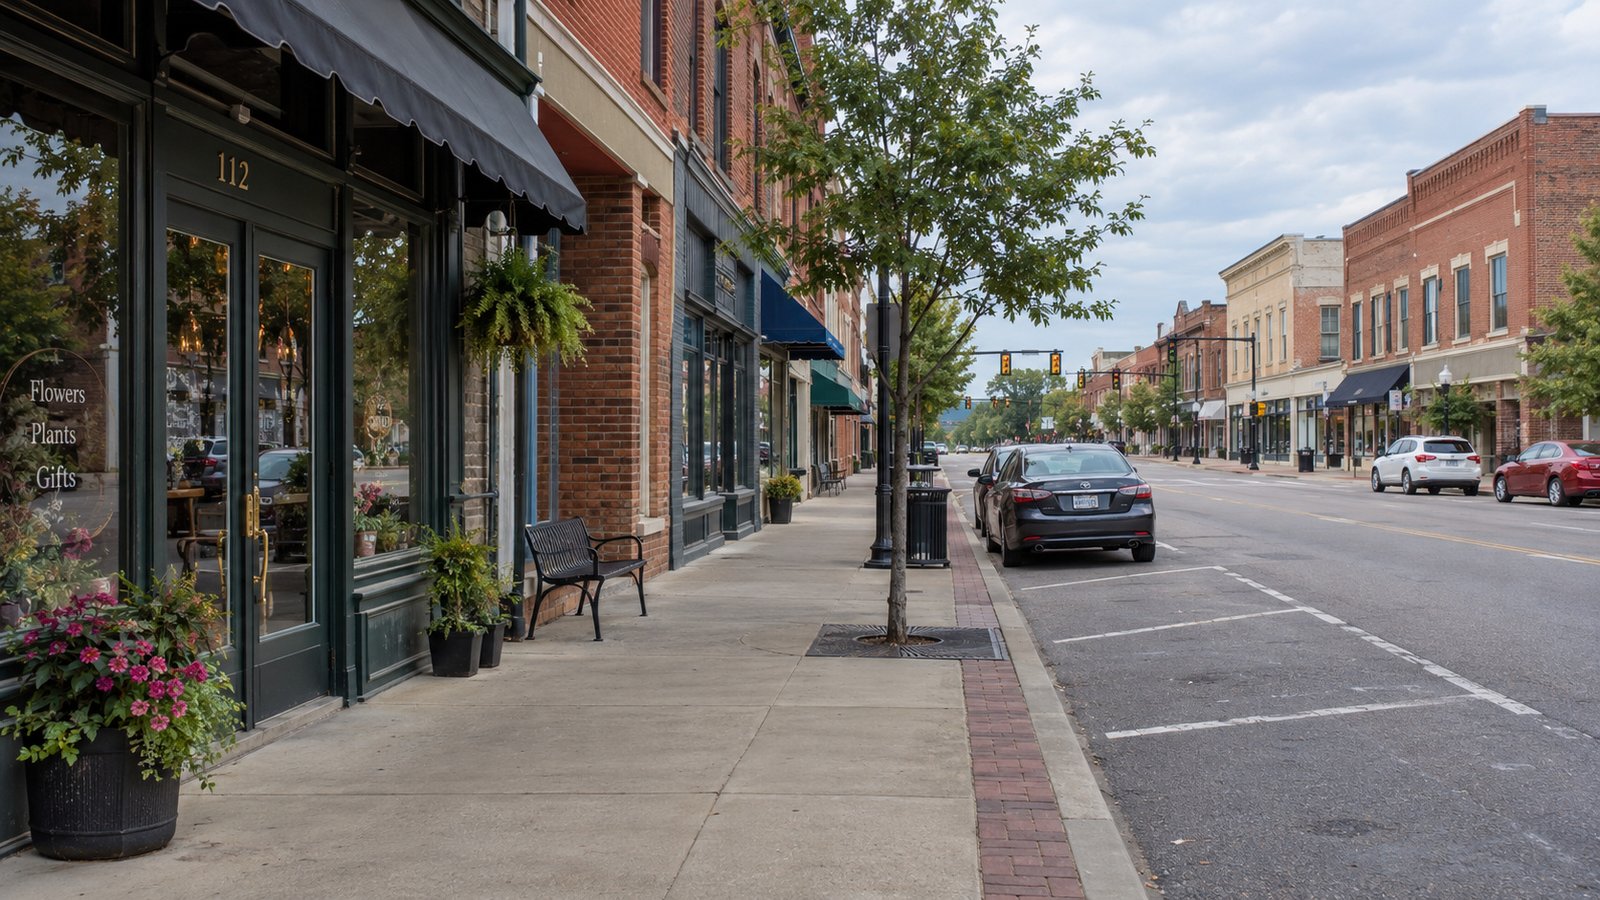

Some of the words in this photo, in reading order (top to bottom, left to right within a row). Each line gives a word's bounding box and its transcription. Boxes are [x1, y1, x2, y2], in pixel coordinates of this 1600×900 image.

[218, 151, 249, 191] 112
[30, 379, 85, 404] Flowers
[31, 423, 77, 445] Plants
[36, 465, 76, 489] Gifts
